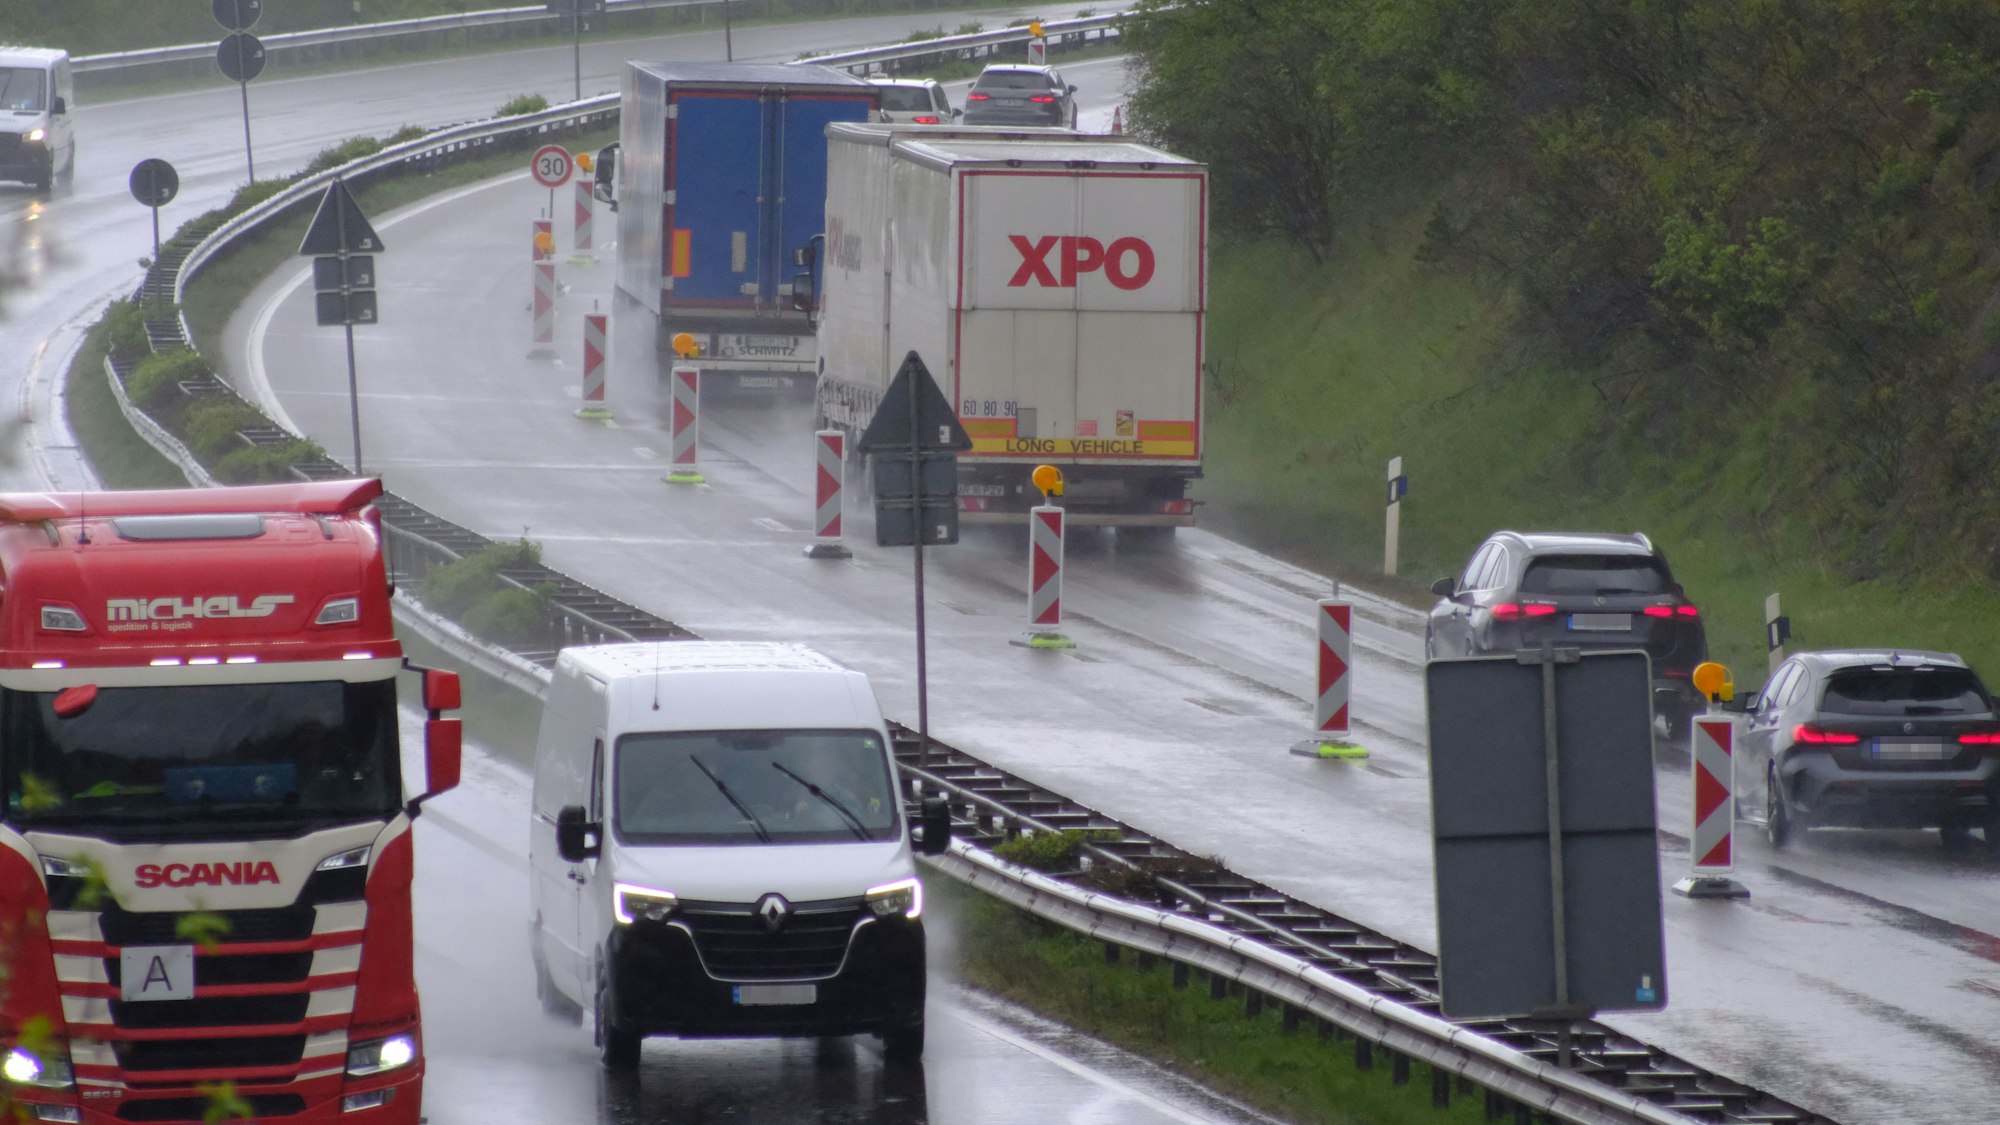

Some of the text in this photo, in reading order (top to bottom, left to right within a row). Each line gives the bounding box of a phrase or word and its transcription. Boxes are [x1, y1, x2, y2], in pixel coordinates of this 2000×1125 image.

[540, 157, 564, 176] 30
[1007, 235, 1155, 291] XPO
[738, 345, 796, 357] SCHMITZ
[963, 400, 1017, 416] 60 80 90
[1006, 439, 1144, 454] LONG VEHICLE
[107, 620, 193, 632] spedition & logistik
[134, 861, 280, 889] SCANIA
[142, 955, 173, 993] A
